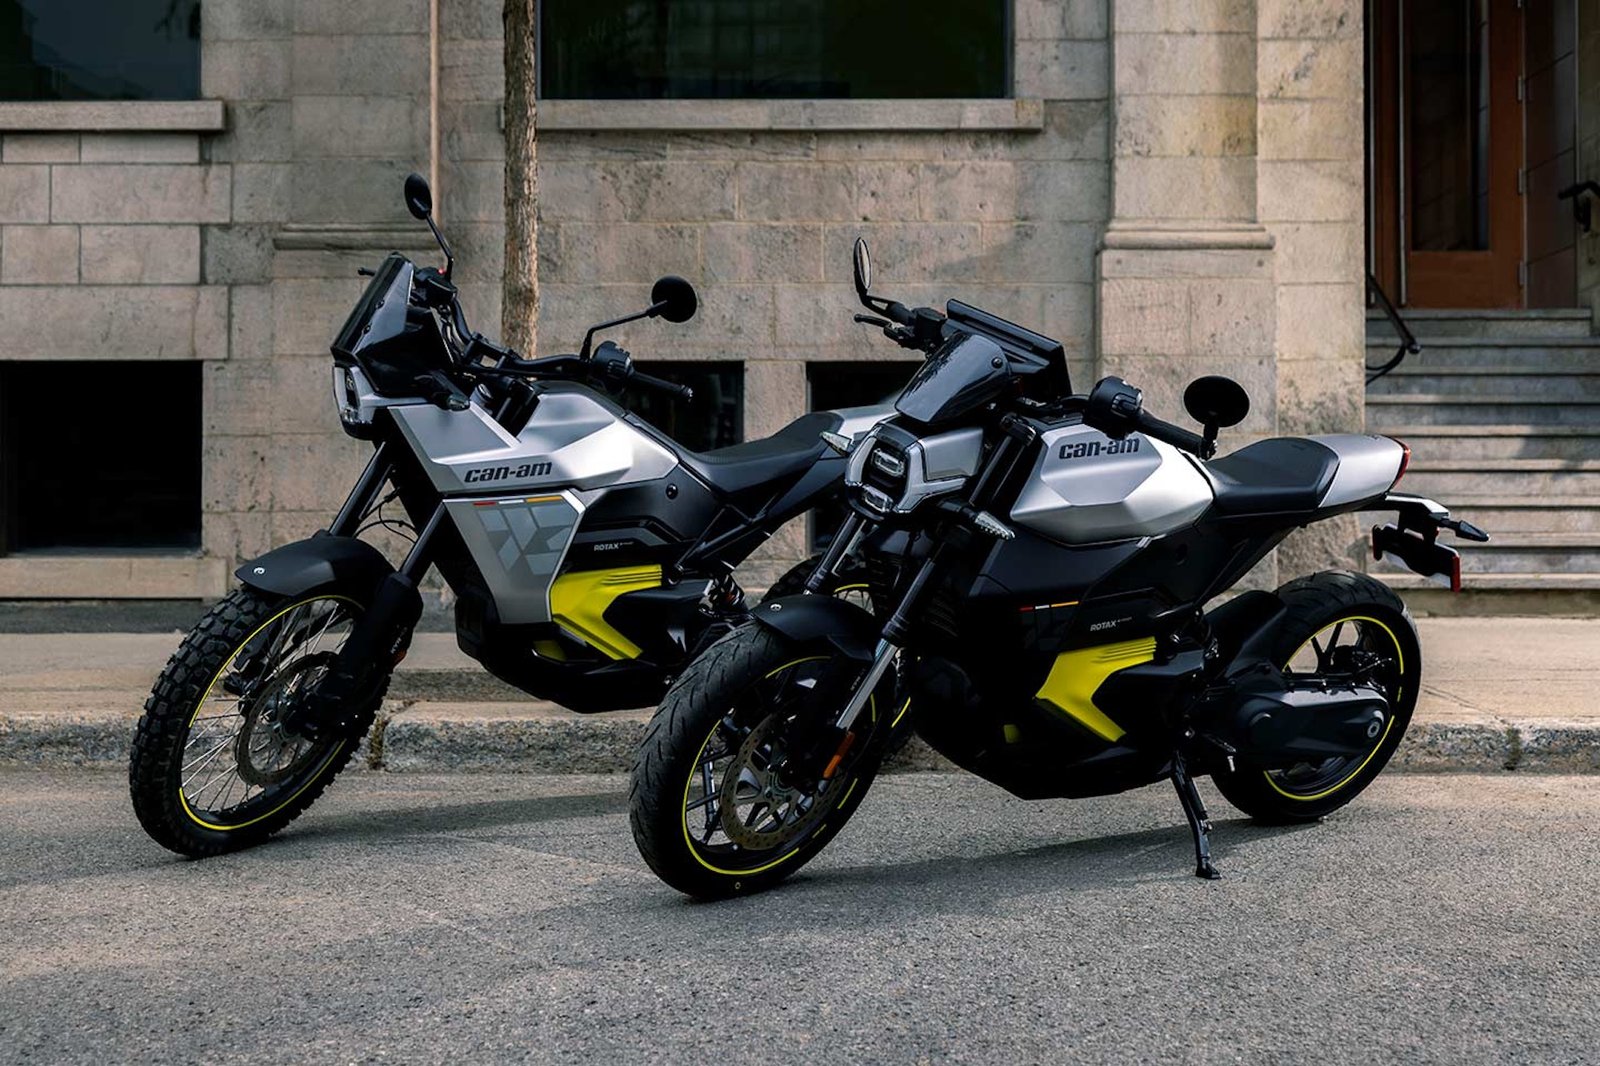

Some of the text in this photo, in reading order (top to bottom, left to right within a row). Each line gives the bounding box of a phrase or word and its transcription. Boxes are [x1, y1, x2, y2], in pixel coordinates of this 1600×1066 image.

[1058, 438, 1140, 459] can-am
[464, 461, 553, 483] can-am
[593, 542, 620, 552] ROTAX
[1089, 620, 1117, 632] ROTAX
